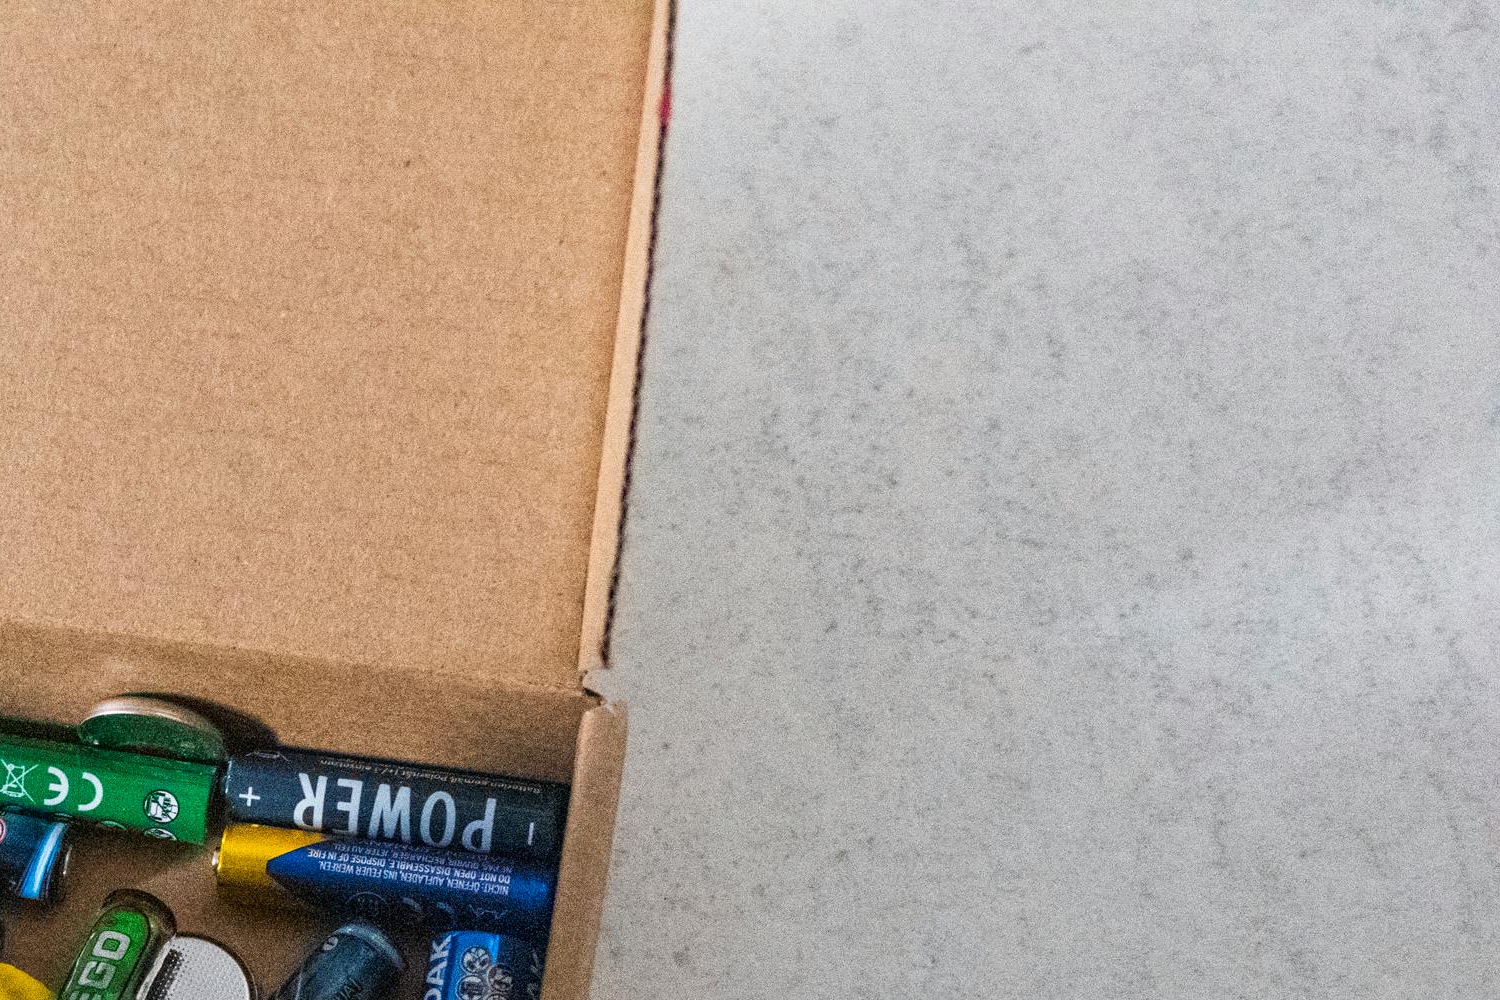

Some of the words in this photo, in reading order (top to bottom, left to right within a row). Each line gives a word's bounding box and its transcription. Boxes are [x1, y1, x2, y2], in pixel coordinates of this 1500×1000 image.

[290, 771, 497, 852] POWER
[327, 850, 337, 860] IN
[337, 851, 350, 863] OF
[350, 853, 386, 868] DISPOSE
[317, 860, 354, 874] WERFEN.
[355, 864, 382, 878] FEUER
[383, 869, 398, 880] INS
[398, 869, 445, 887] AUFLADEN,
[497, 873, 511, 885] DO
